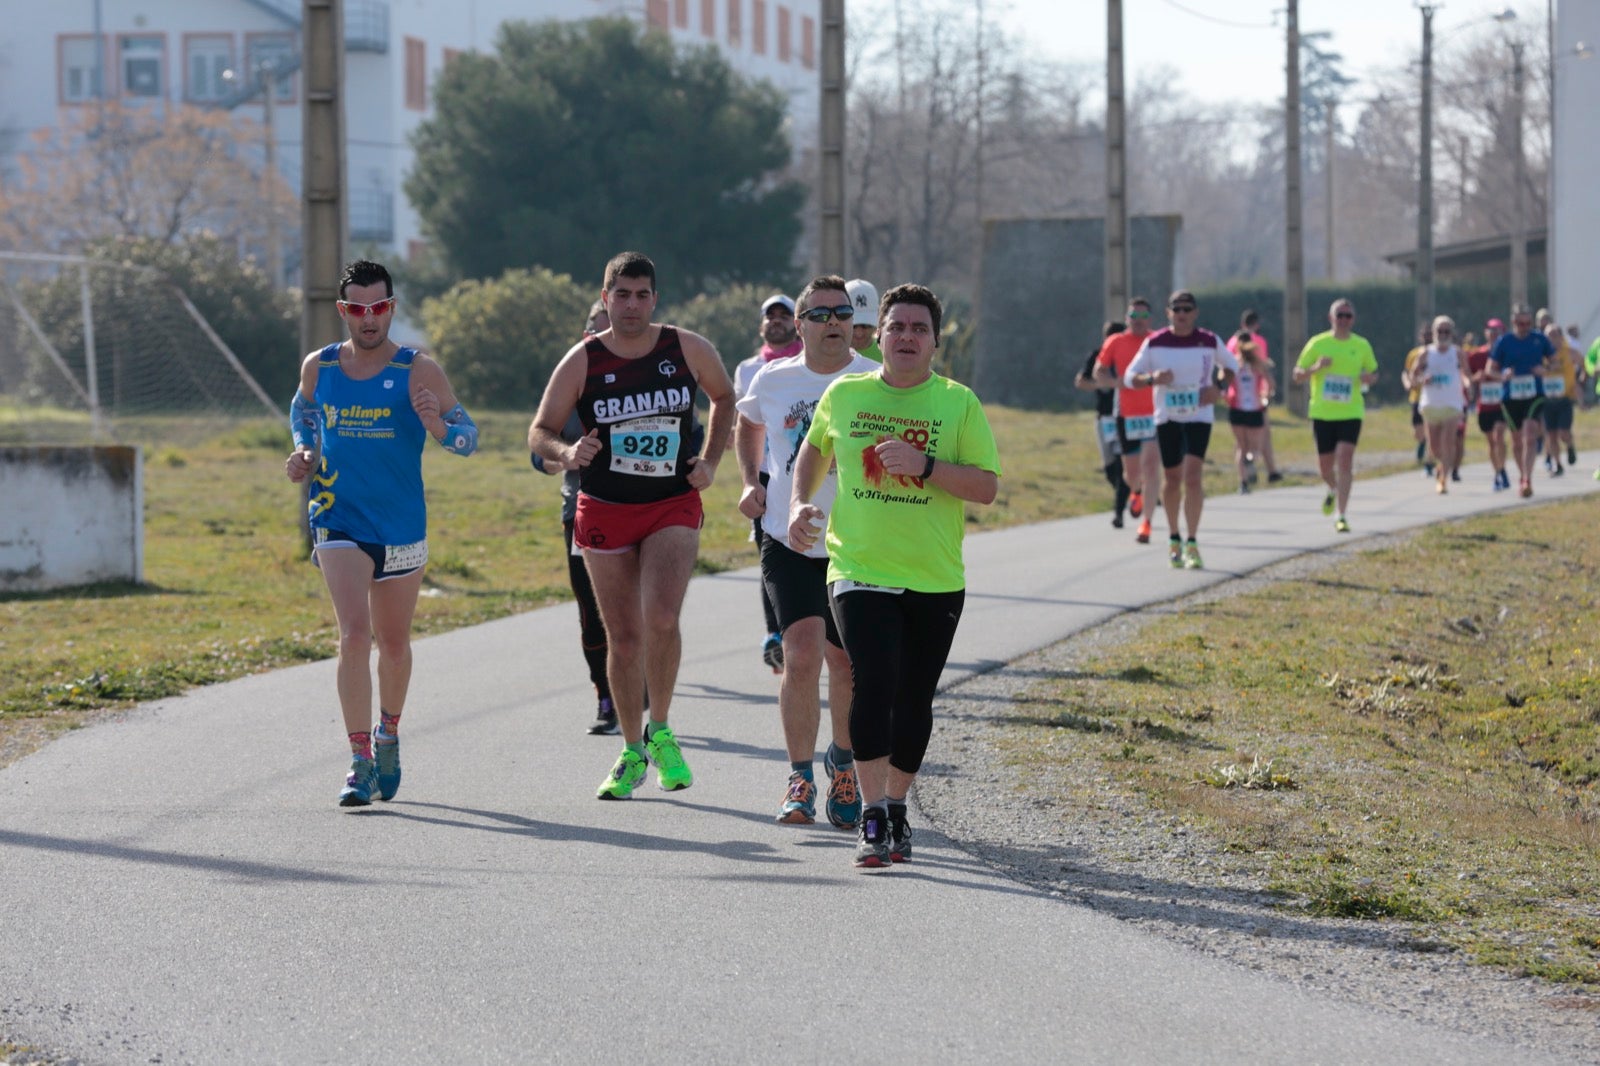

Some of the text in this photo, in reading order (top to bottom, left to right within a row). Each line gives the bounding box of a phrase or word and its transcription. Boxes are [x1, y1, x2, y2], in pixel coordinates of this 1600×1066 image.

[593, 386, 691, 419] GRANADA
[1171, 392, 1194, 406] 151
[341, 405, 391, 421] olimpo
[857, 412, 930, 428] GRAN PREMIO
[340, 418, 373, 426] deportes
[863, 422, 895, 433] FONDO
[931, 419, 942, 434] FE
[338, 430, 356, 438] TRAIL
[363, 431, 396, 439] RUNNING
[623, 435, 669, 457] 928
